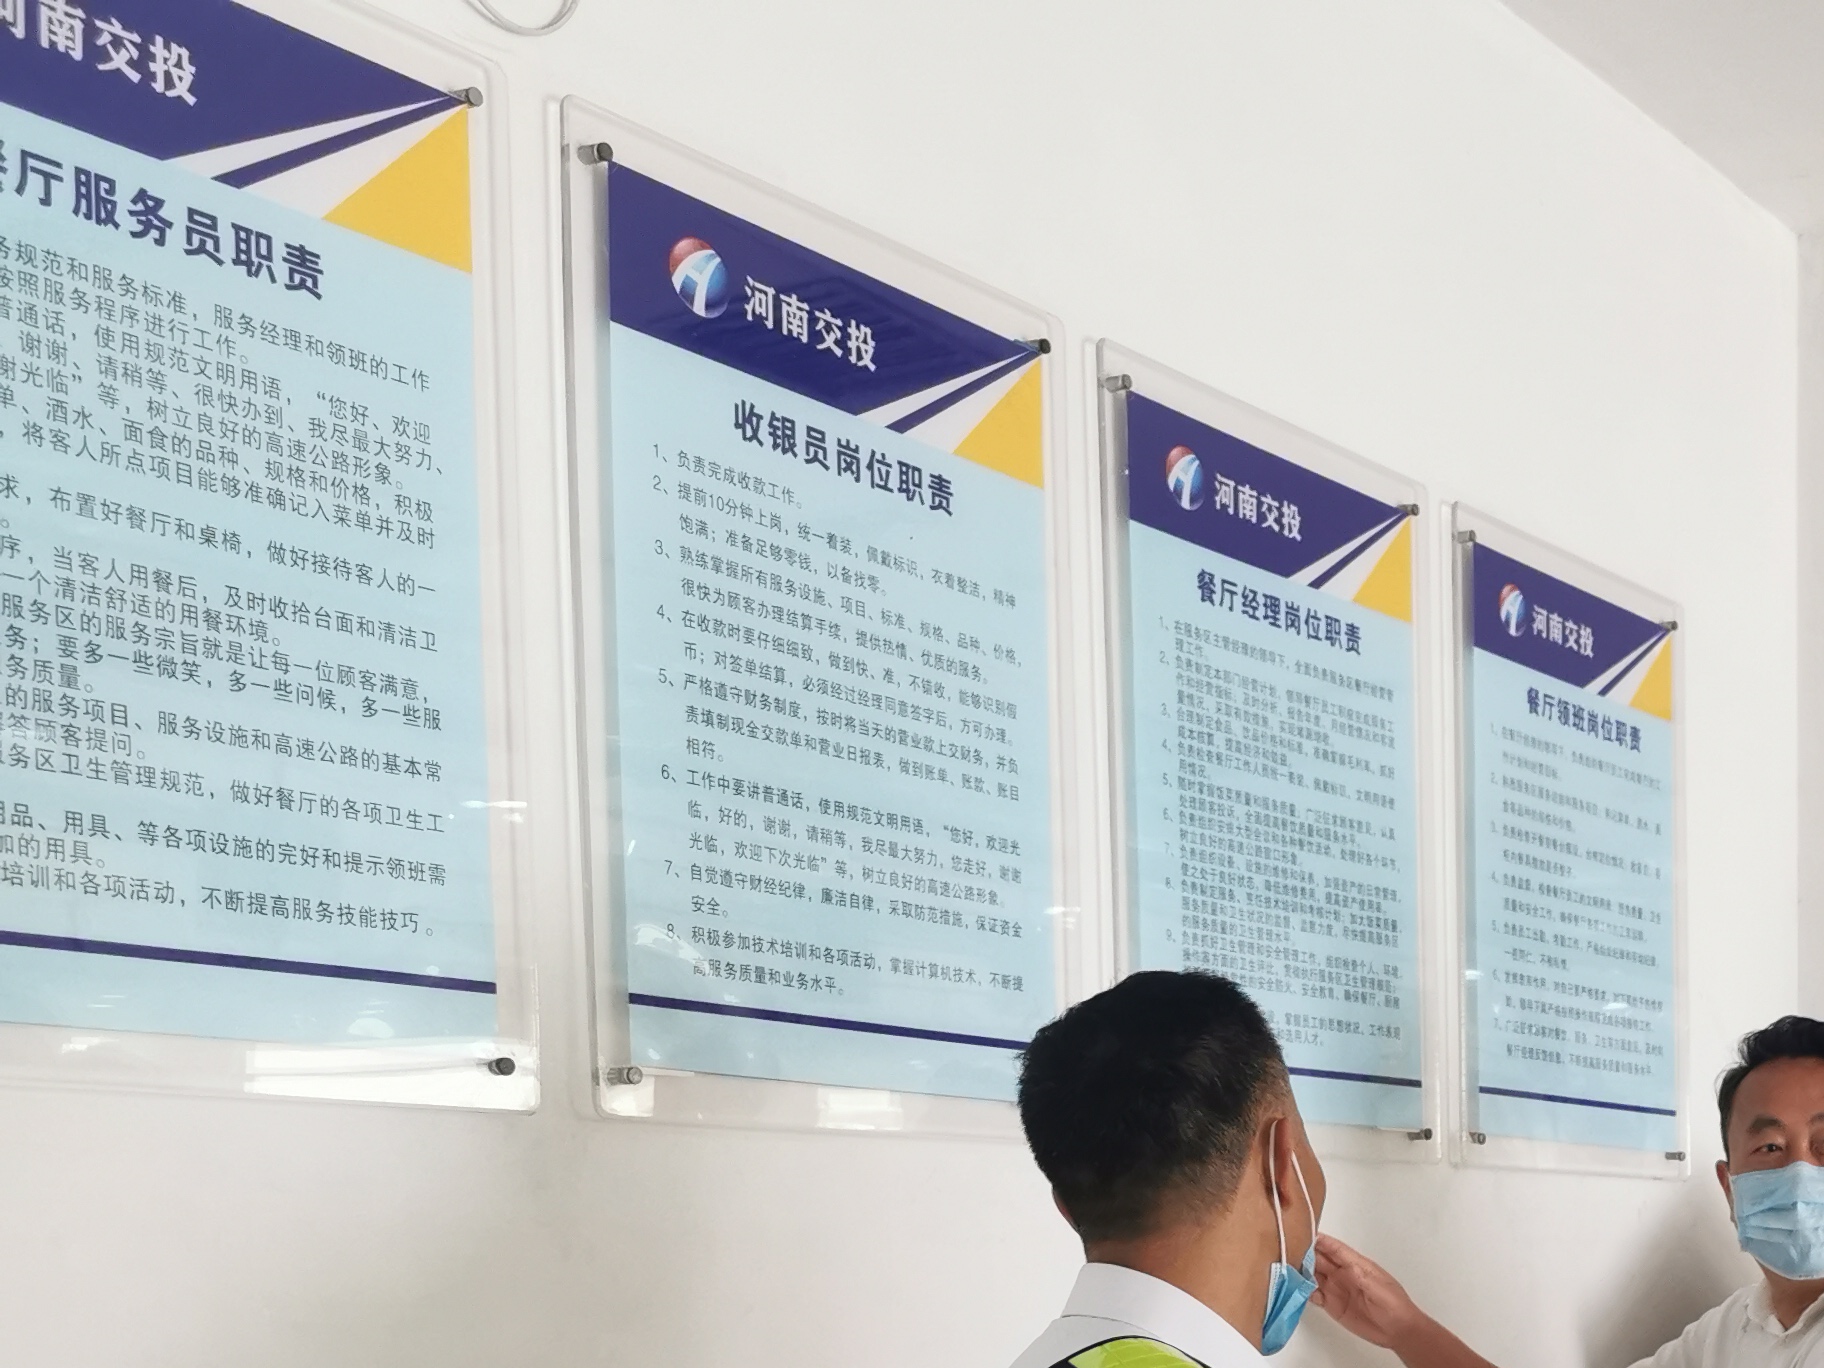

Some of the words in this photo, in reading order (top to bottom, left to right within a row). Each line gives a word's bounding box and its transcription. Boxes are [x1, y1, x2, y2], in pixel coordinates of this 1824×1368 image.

[0, 140, 324, 300] 厅服务员职责
[743, 274, 876, 372] 河南交投
[734, 400, 955, 518] 收银员岗位职责
[1214, 473, 1302, 541] 河南交投
[1197, 568, 1362, 655] 餐厅经理岗位职责
[1531, 604, 1595, 658] 河南交投
[0, 654, 94, 693] 务质量。
[0, 624, 441, 731] 务；要多一些微笑，多一些问候，多一些服
[0, 711, 145, 760] 答顾客提问。
[686, 736, 724, 762] 相符。
[1526, 686, 1642, 753] 餐厅领班岗位职责
[0, 742, 445, 833] 务区卫生管理规范，做好餐厅的各项卫生工
[0, 802, 446, 887] 品、用具、等各项设施的完好和提示领班需
[691, 895, 729, 919] 安全。
